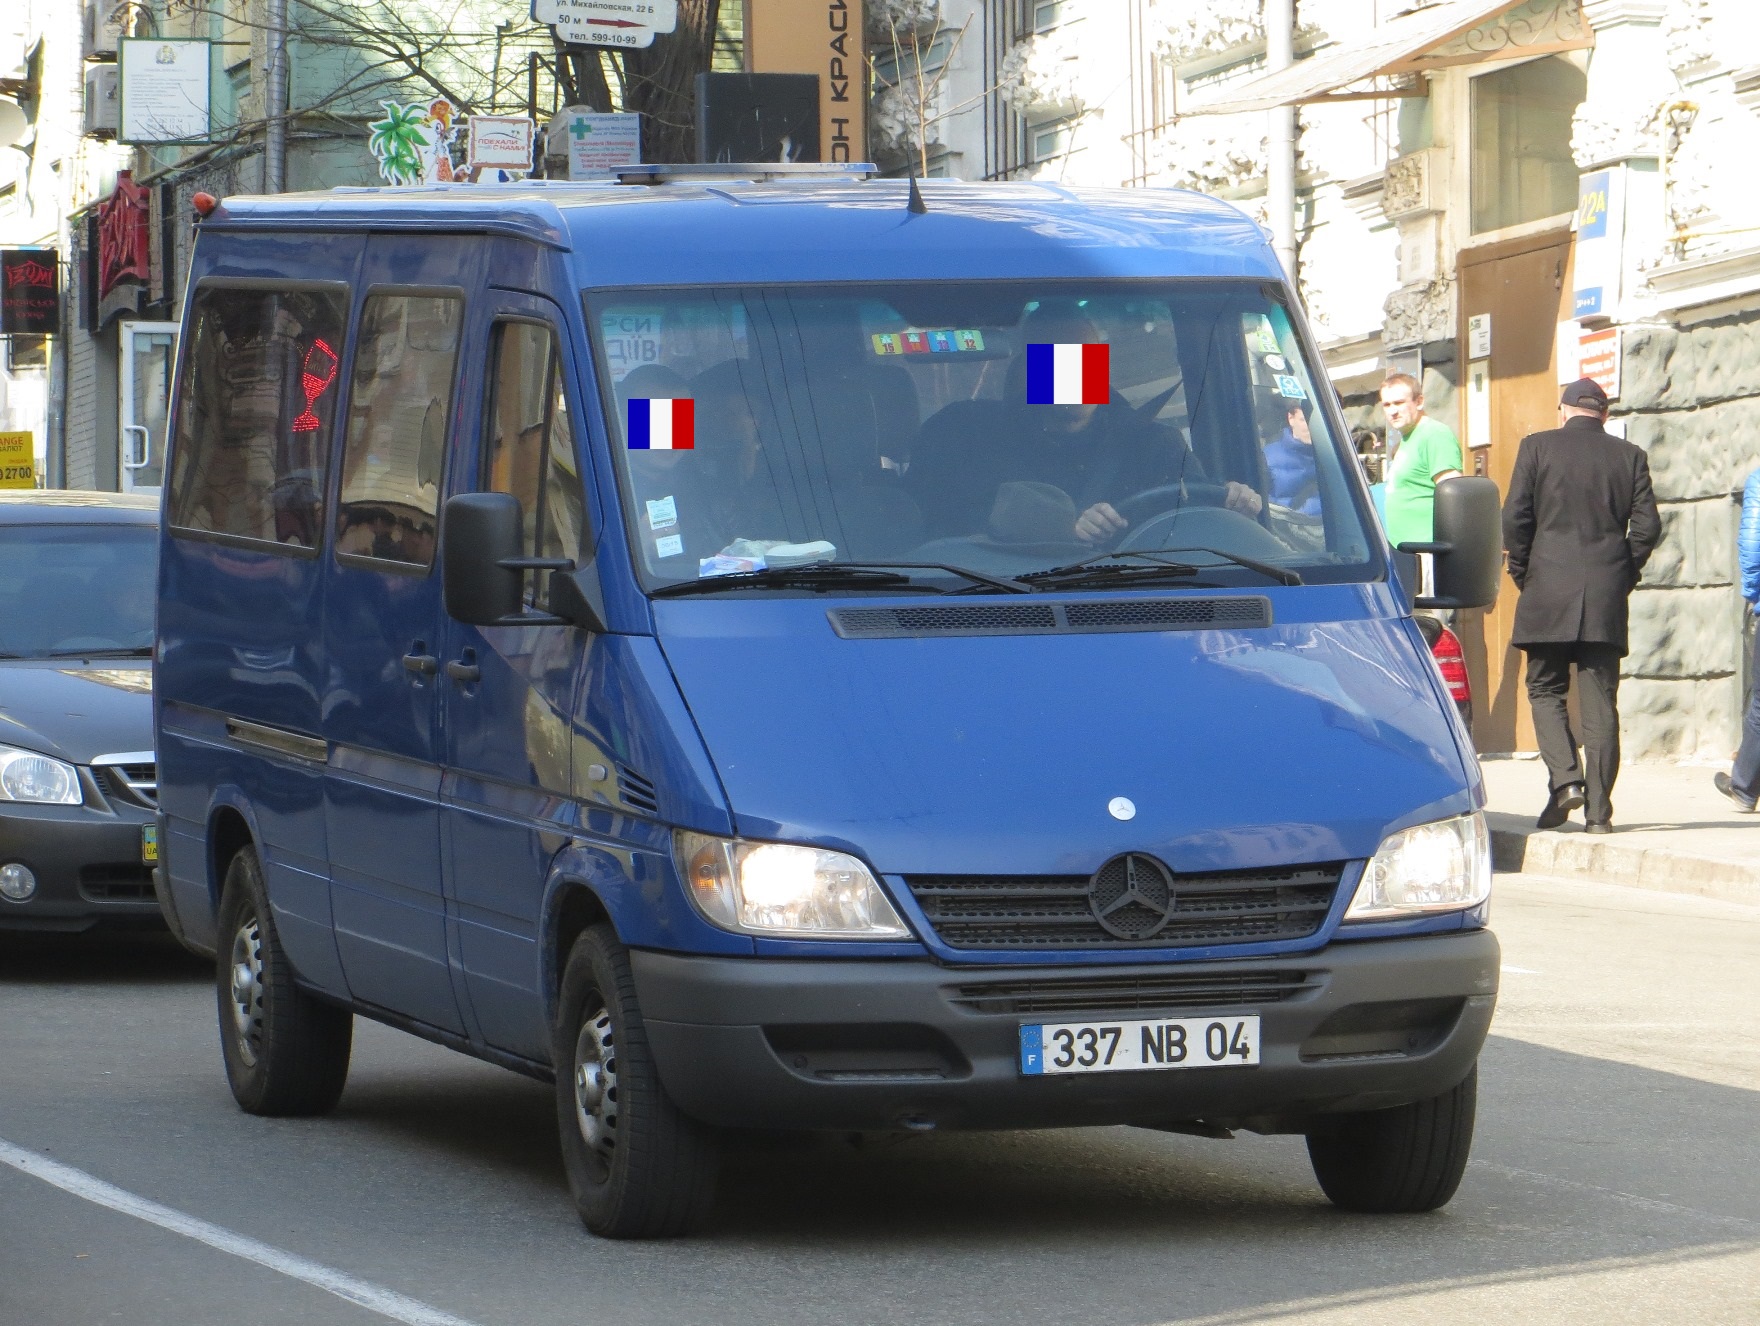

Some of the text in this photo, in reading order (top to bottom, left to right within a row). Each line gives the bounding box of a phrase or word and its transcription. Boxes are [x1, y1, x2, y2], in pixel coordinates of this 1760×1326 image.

[636, 5, 646, 13] 22
[558, 15, 570, 24] 50
[569, 33, 637, 44] тел. 599-10-99
[1027, 1021, 1250, 1068] F 337 NB 04
